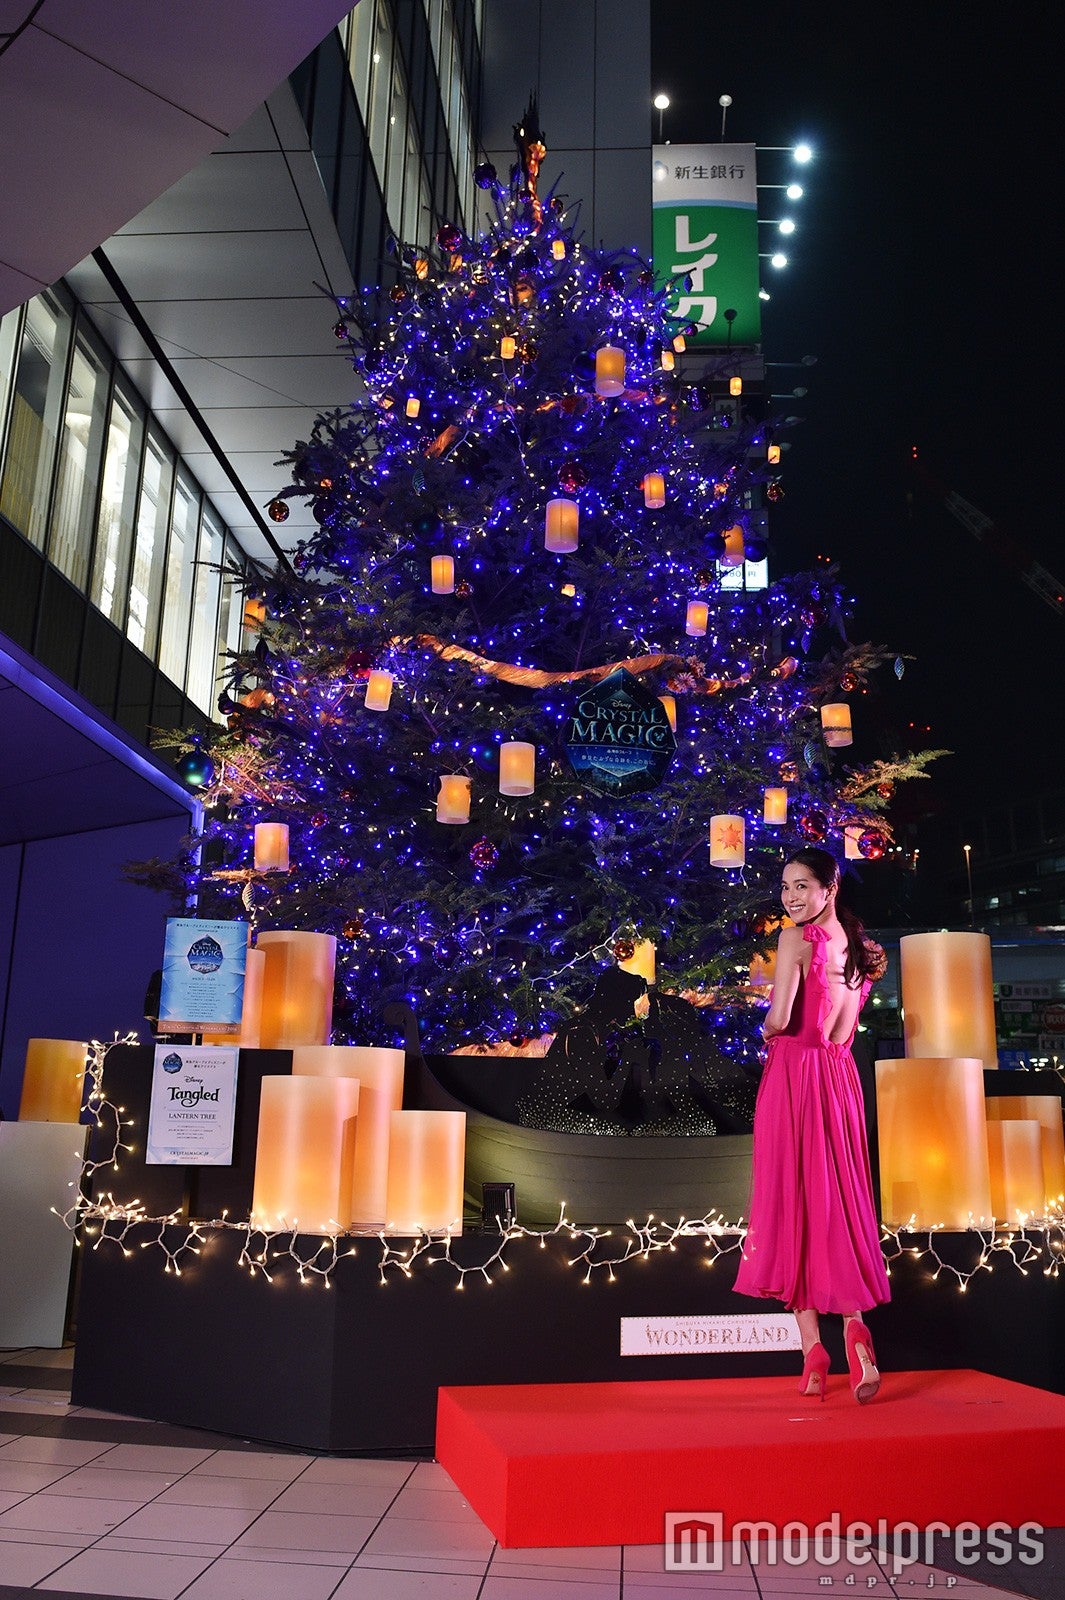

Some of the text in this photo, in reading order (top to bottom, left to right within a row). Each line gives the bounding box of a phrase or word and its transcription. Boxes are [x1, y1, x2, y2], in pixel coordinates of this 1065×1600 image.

[674, 165, 745, 180] 新生銀行
[671, 215, 718, 335] レイク
[578, 700, 663, 724] CRYSTAL
[569, 717, 668, 748] MAGIC
[183, 1075, 203, 1083] Disney
[167, 1086, 221, 1108] Tangled
[645, 1324, 789, 1347] WONDERLAND
